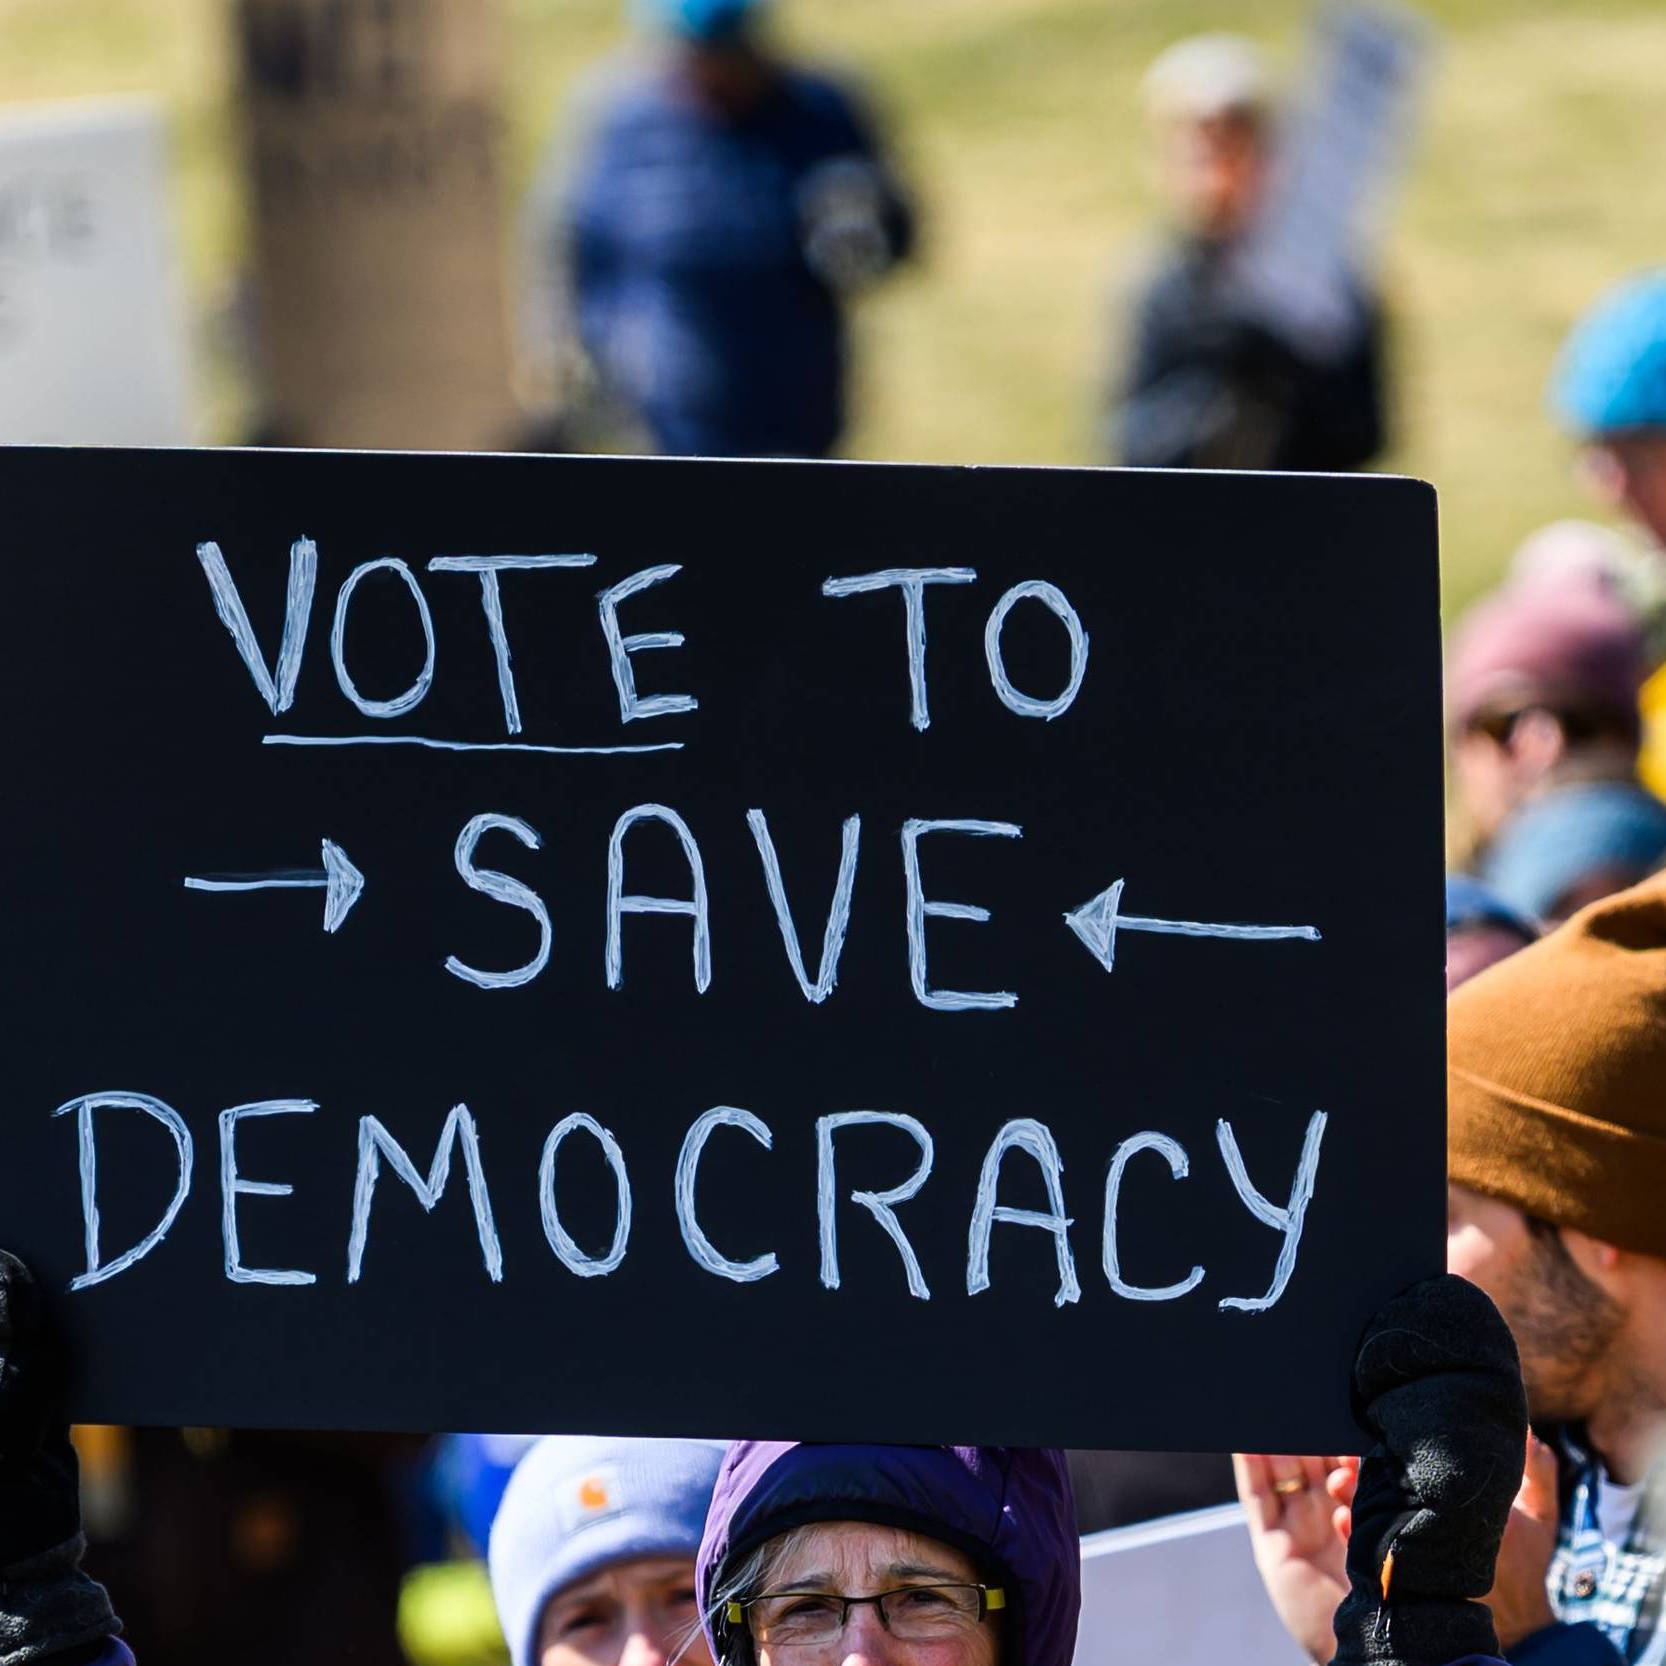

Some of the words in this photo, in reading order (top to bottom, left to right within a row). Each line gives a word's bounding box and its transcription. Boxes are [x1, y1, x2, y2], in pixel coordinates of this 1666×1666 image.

[195, 534, 700, 733] VOTE
[821, 565, 1090, 731] TO
[444, 802, 1025, 1011] SAVE
[51, 1088, 1329, 1314] DEMOCRACY
